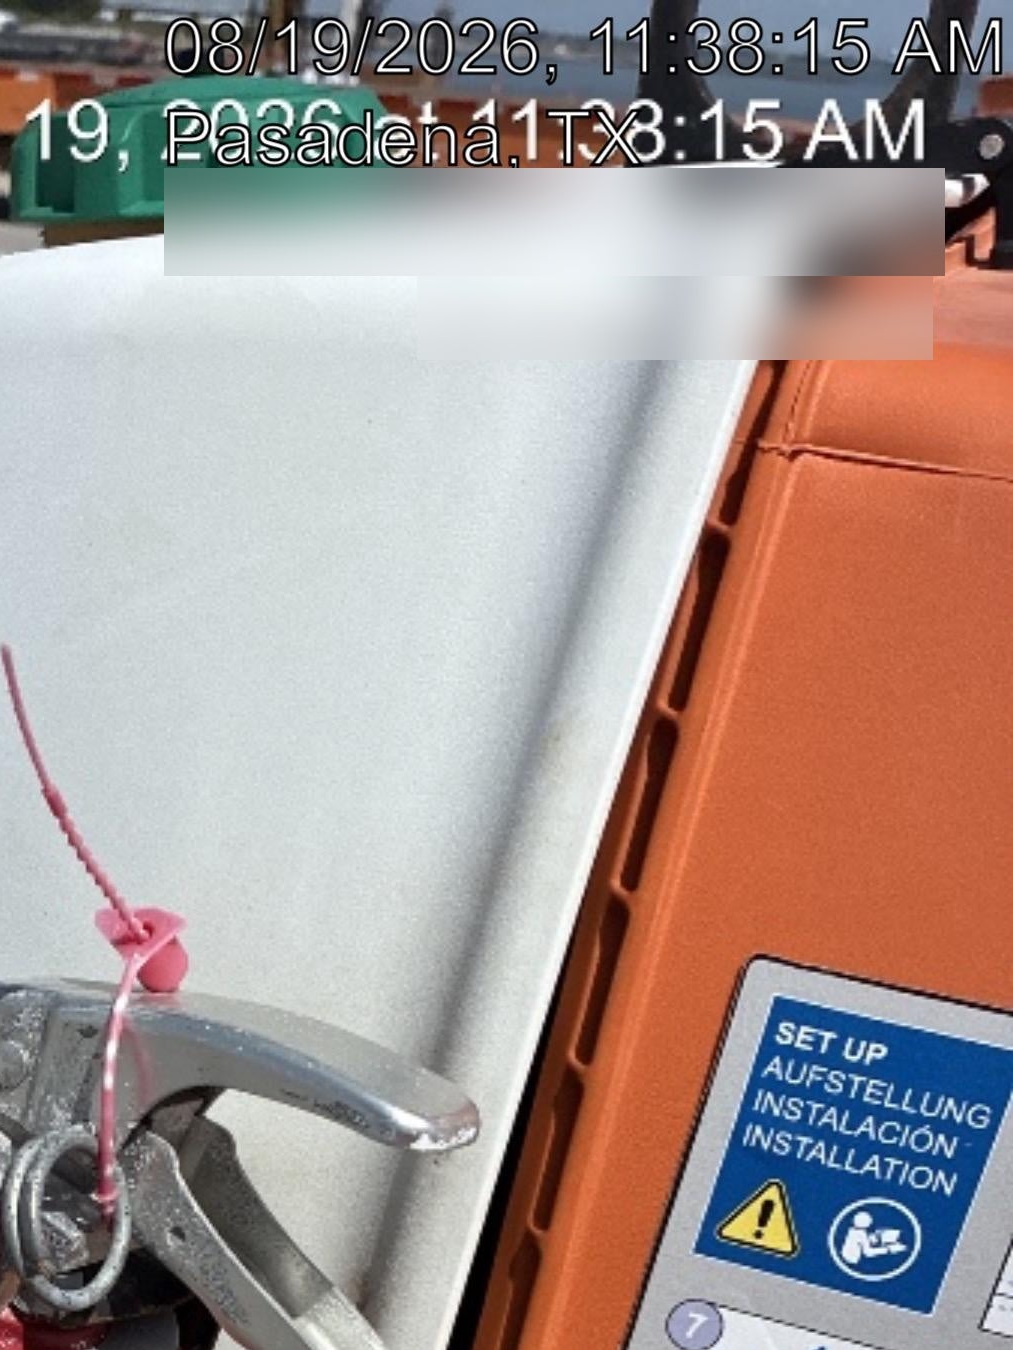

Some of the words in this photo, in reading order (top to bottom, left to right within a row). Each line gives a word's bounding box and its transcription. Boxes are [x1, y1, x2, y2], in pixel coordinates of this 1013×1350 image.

[774, 1021, 838, 1054] SET
[842, 1036, 889, 1066] UP
[752, 1089, 958, 1160] INSTALACIÓN
[761, 1055, 992, 1129] AUFSTELLUNG
[742, 1122, 958, 1197] INSTALLATION
[685, 1311, 709, 1339] 7
